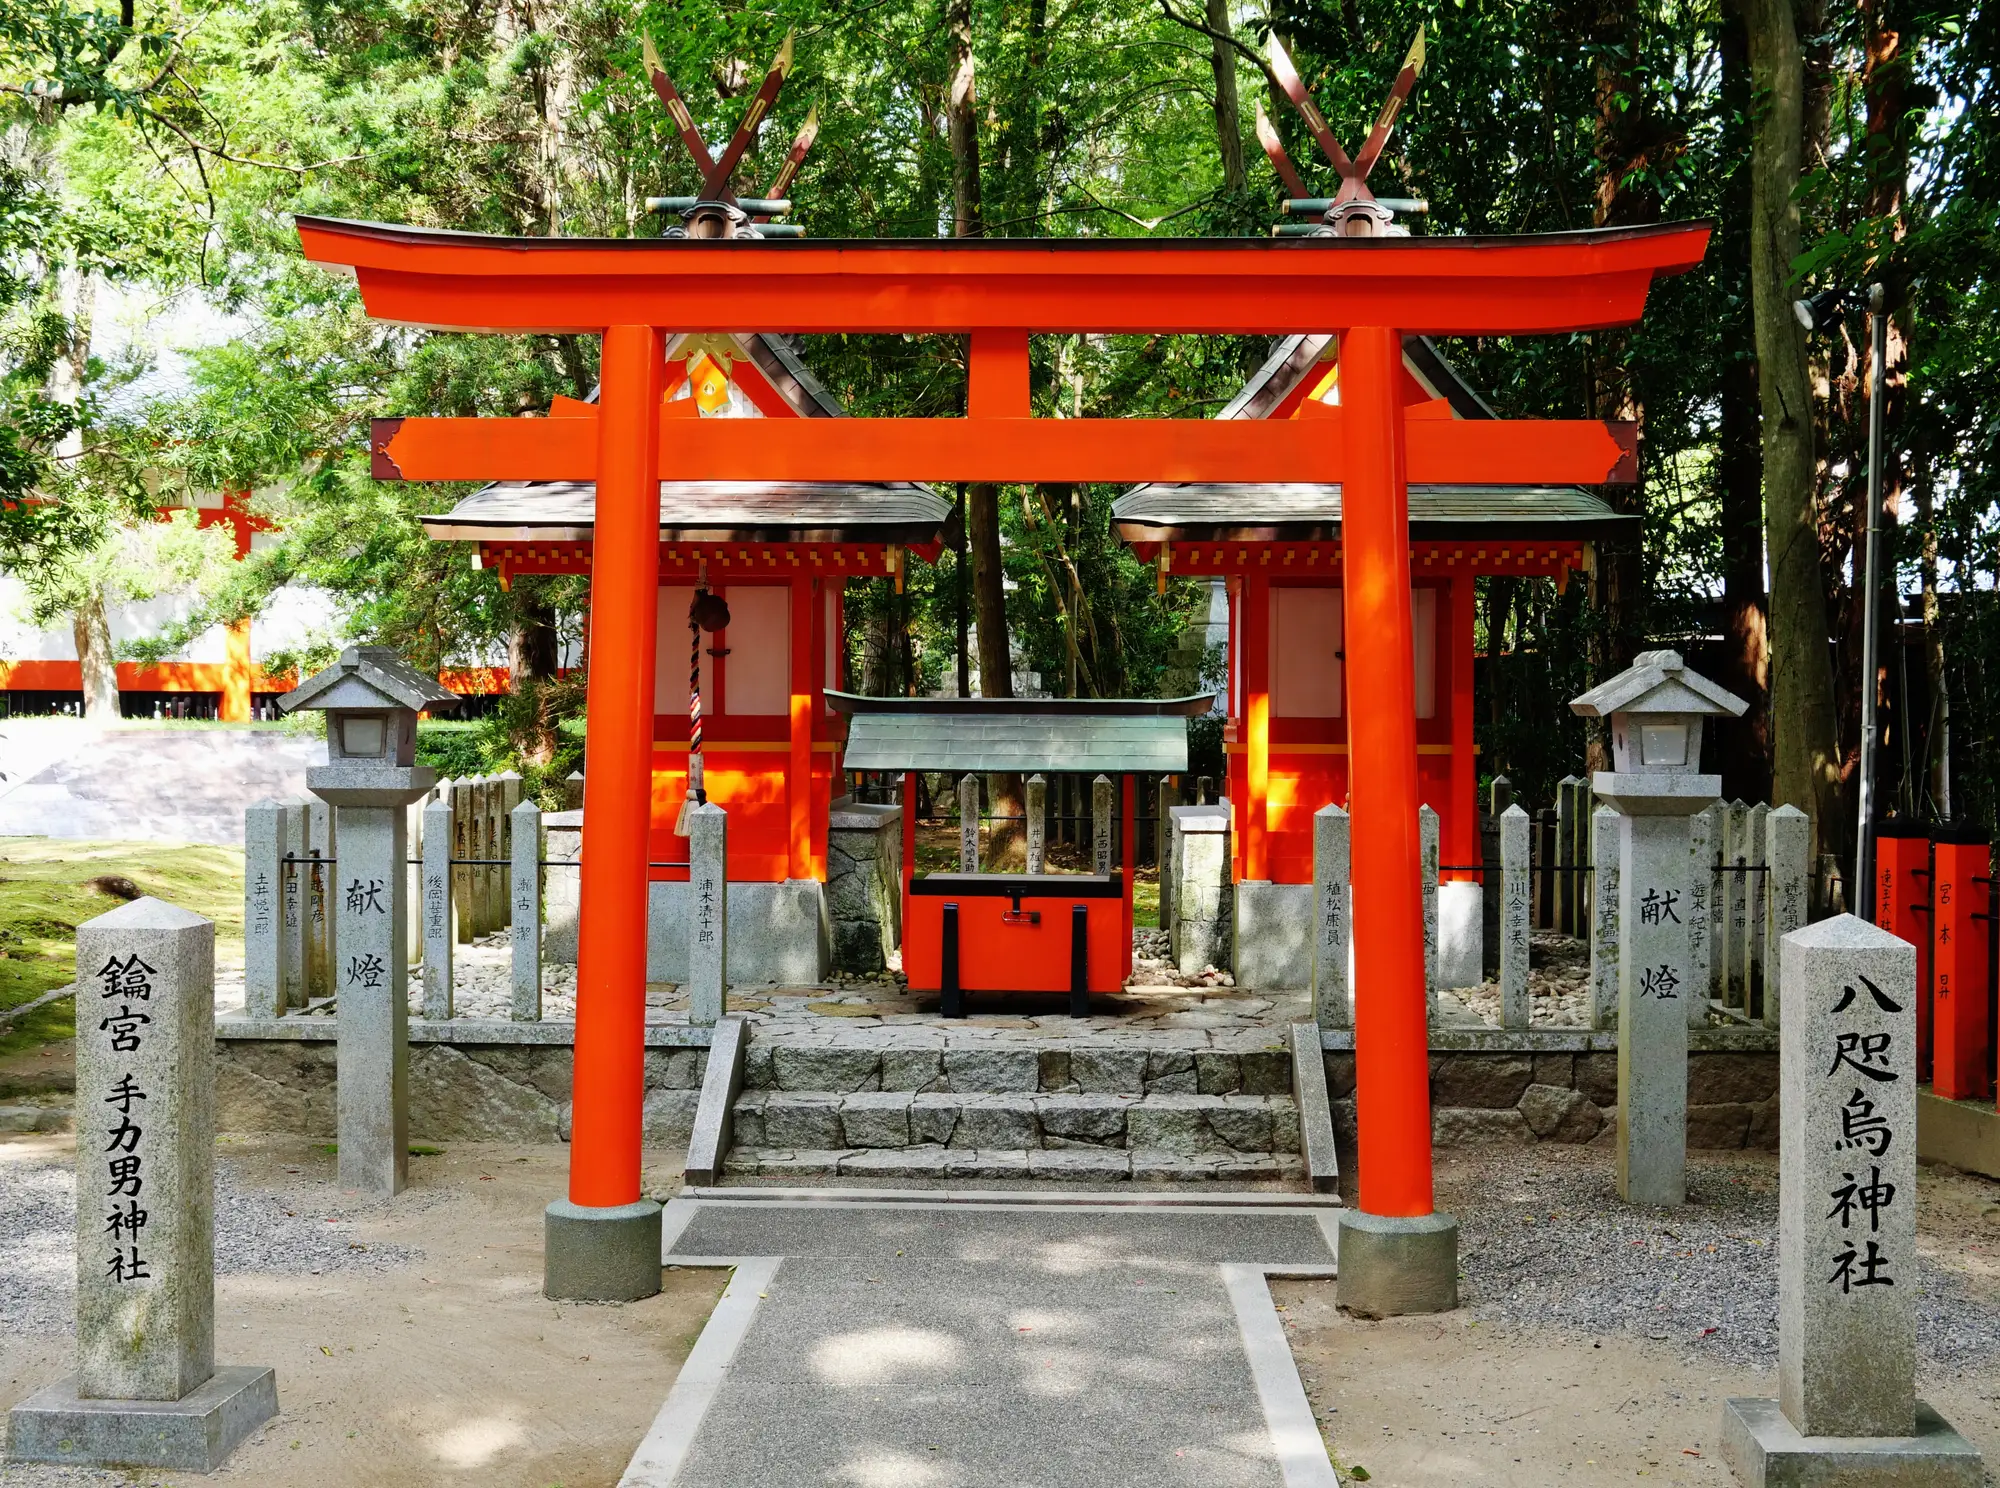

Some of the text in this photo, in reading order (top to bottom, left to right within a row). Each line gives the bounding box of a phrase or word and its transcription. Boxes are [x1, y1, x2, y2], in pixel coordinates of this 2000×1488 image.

[345, 877, 387, 989] 献燈
[698, 878, 714, 944] 浦木清十郎
[1640, 888, 1682, 1000] 献燈
